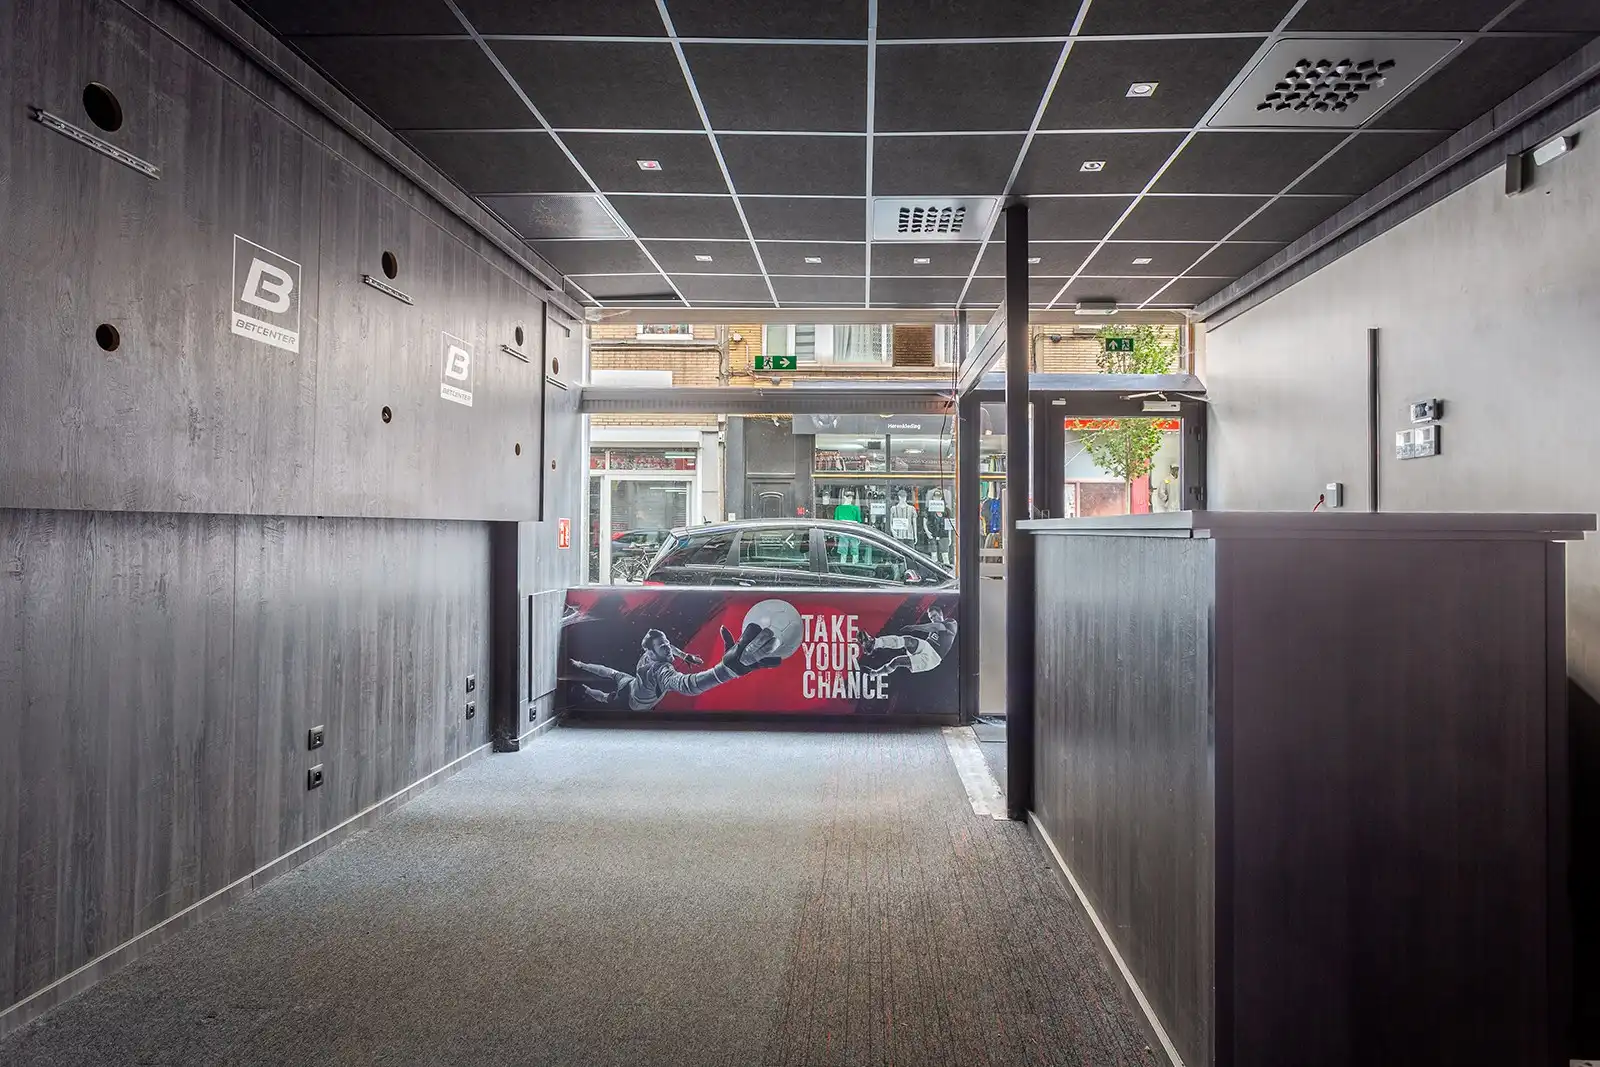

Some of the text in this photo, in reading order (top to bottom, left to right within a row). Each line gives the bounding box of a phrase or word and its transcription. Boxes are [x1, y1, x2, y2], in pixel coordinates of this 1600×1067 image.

[241, 257, 294, 314] B
[236, 319, 296, 345] BETCENTER
[445, 344, 470, 381] B
[442, 387, 471, 401] BETCENTER
[801, 614, 859, 643] TAKE
[802, 642, 861, 671] YOUR
[802, 670, 889, 700] CHANCE
